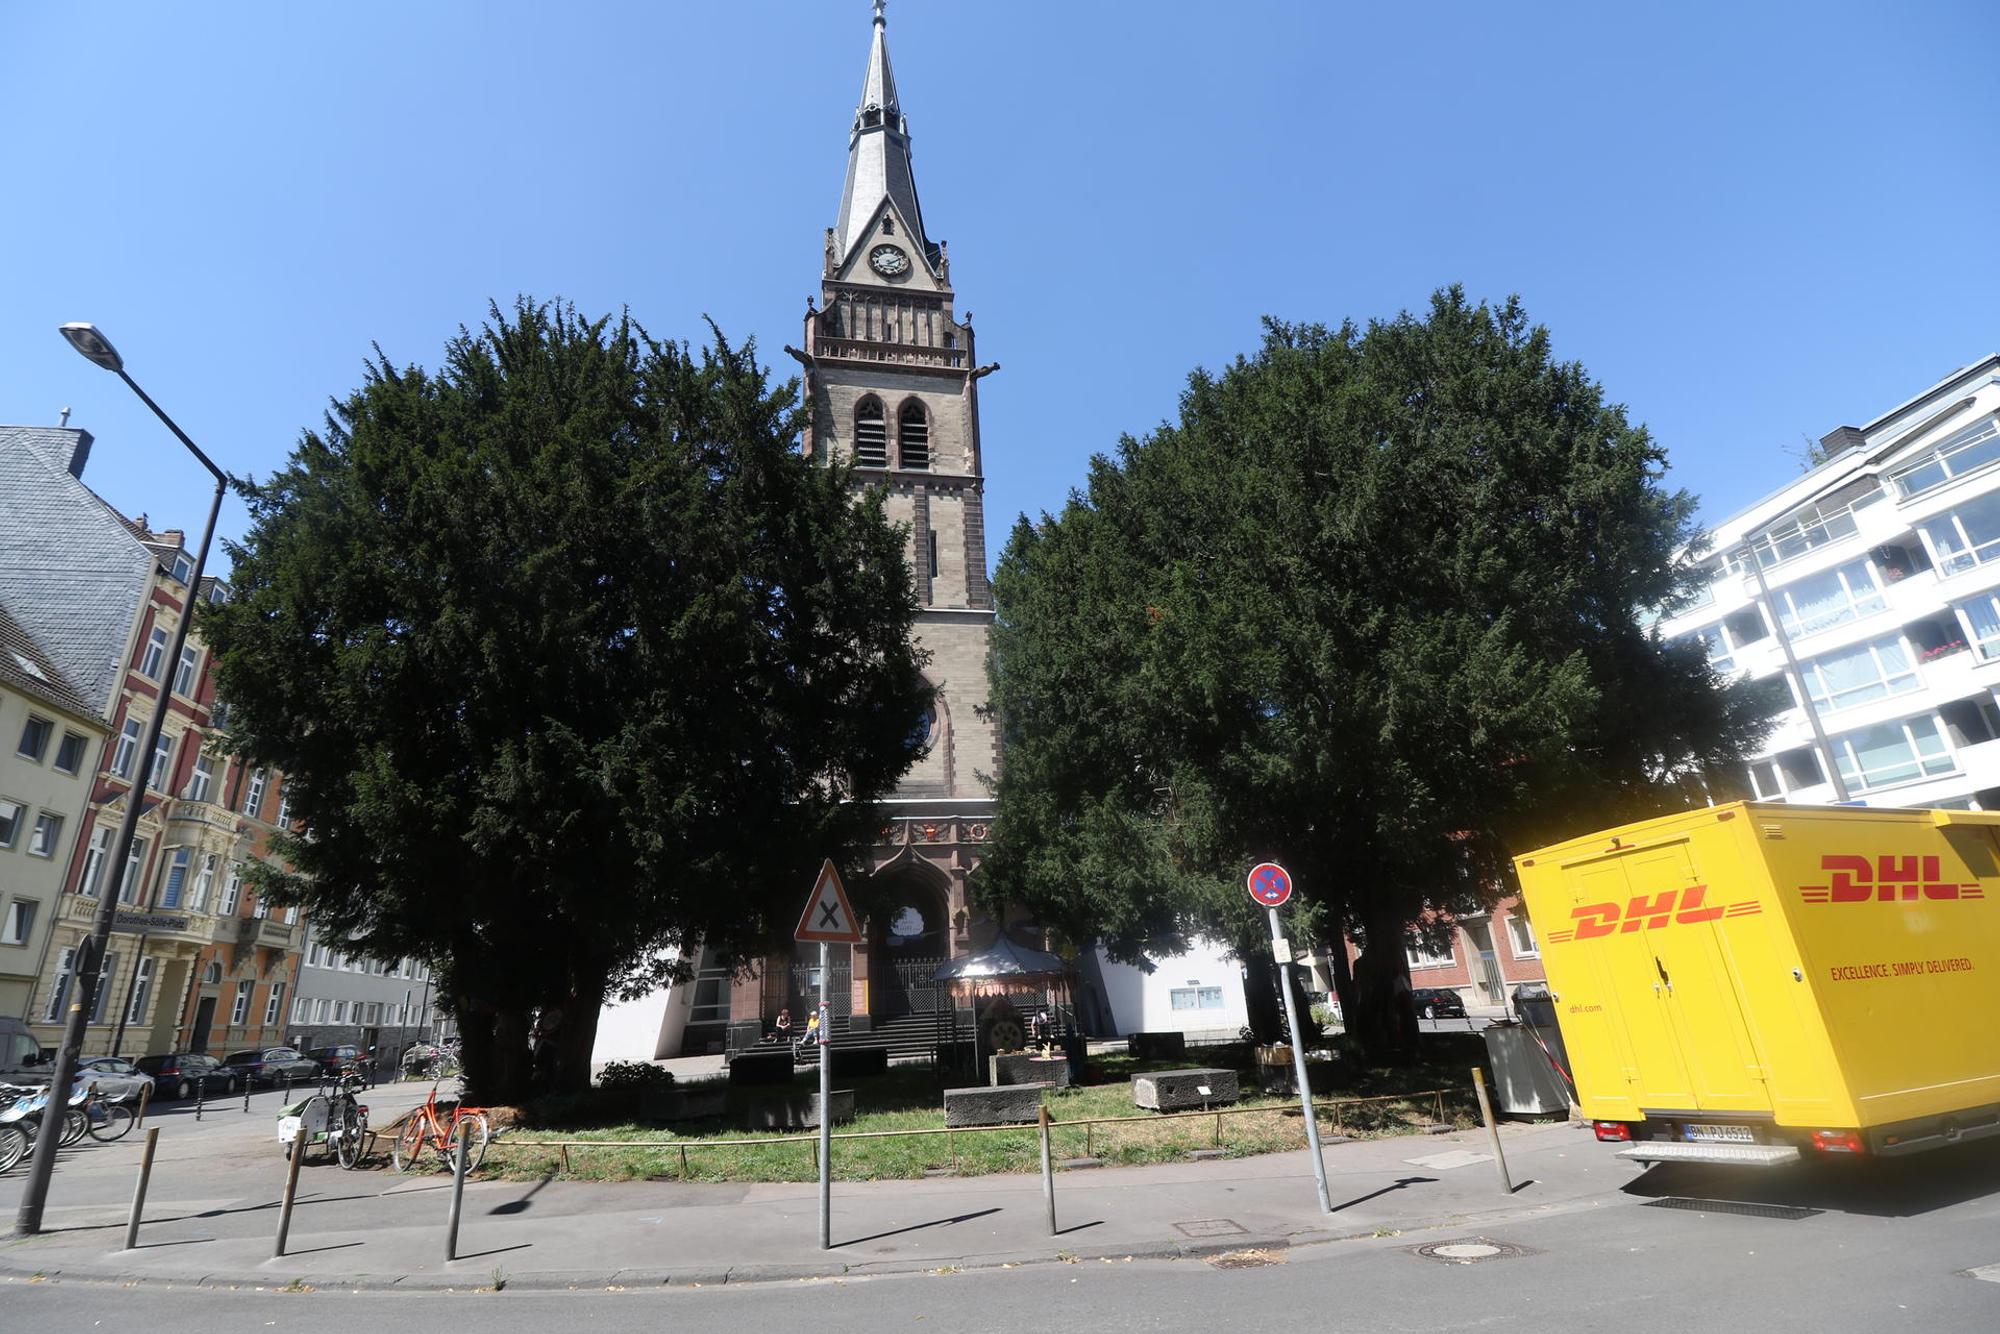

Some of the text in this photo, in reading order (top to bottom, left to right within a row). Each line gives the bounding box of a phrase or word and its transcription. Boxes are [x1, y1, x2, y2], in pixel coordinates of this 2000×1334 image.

[1821, 855, 1959, 903] DHL
[1571, 884, 1726, 941] DHL
[1831, 958, 1975, 981] EXCELLENCE. SIMPLY DELIVERED.
[1569, 1003, 1603, 1014] dhl.com
[1690, 1125, 1705, 1138] BN
